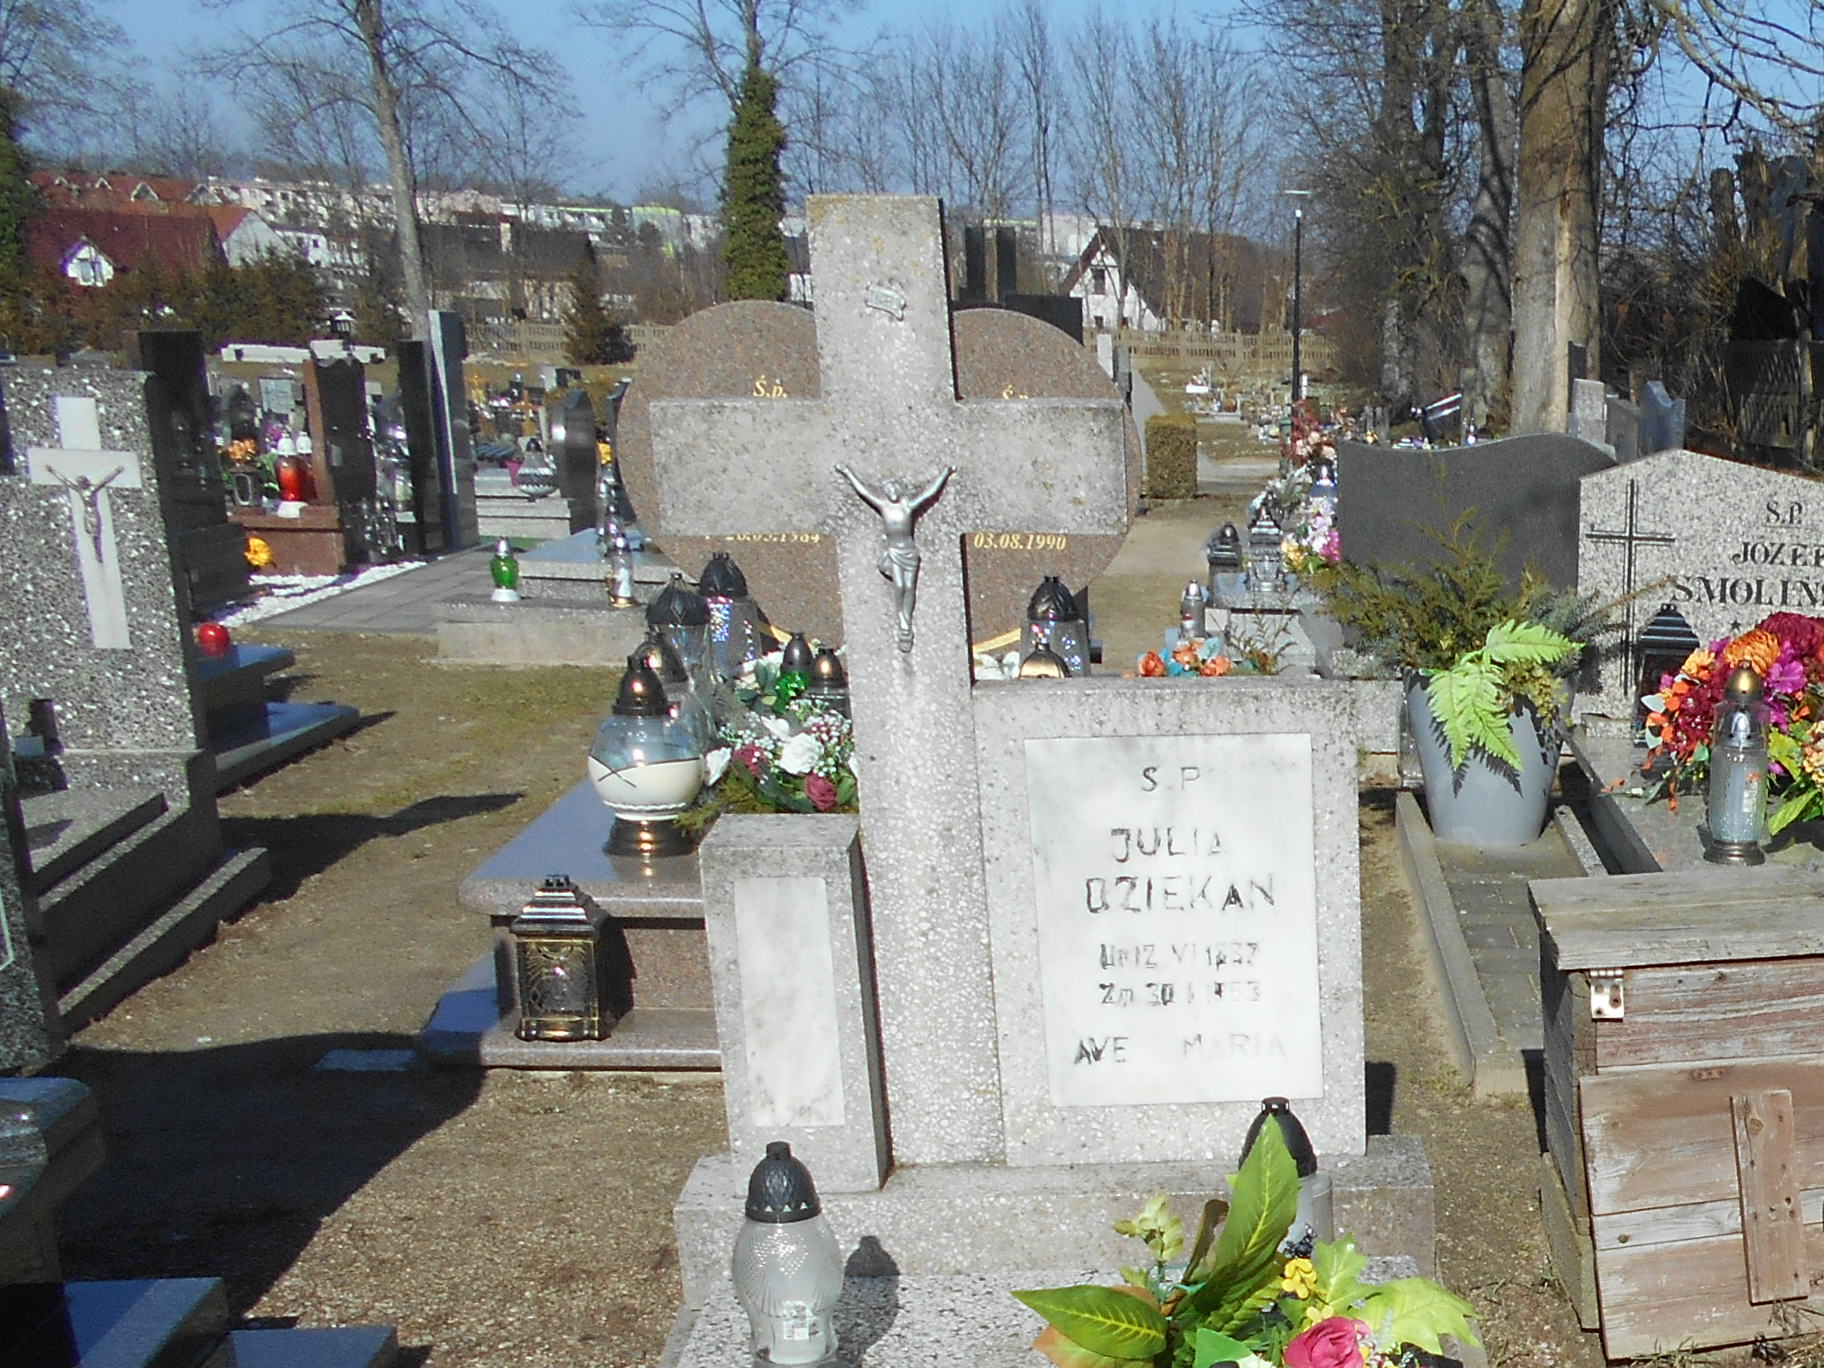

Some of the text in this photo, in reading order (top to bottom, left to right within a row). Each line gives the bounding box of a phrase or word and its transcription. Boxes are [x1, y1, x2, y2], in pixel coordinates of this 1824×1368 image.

[973, 532, 1067, 550] 03.08.1990
[1110, 827, 1229, 863] JULIA
[1085, 873, 1276, 913] DZIEKAN
[1074, 1035, 1130, 1066] AVE
